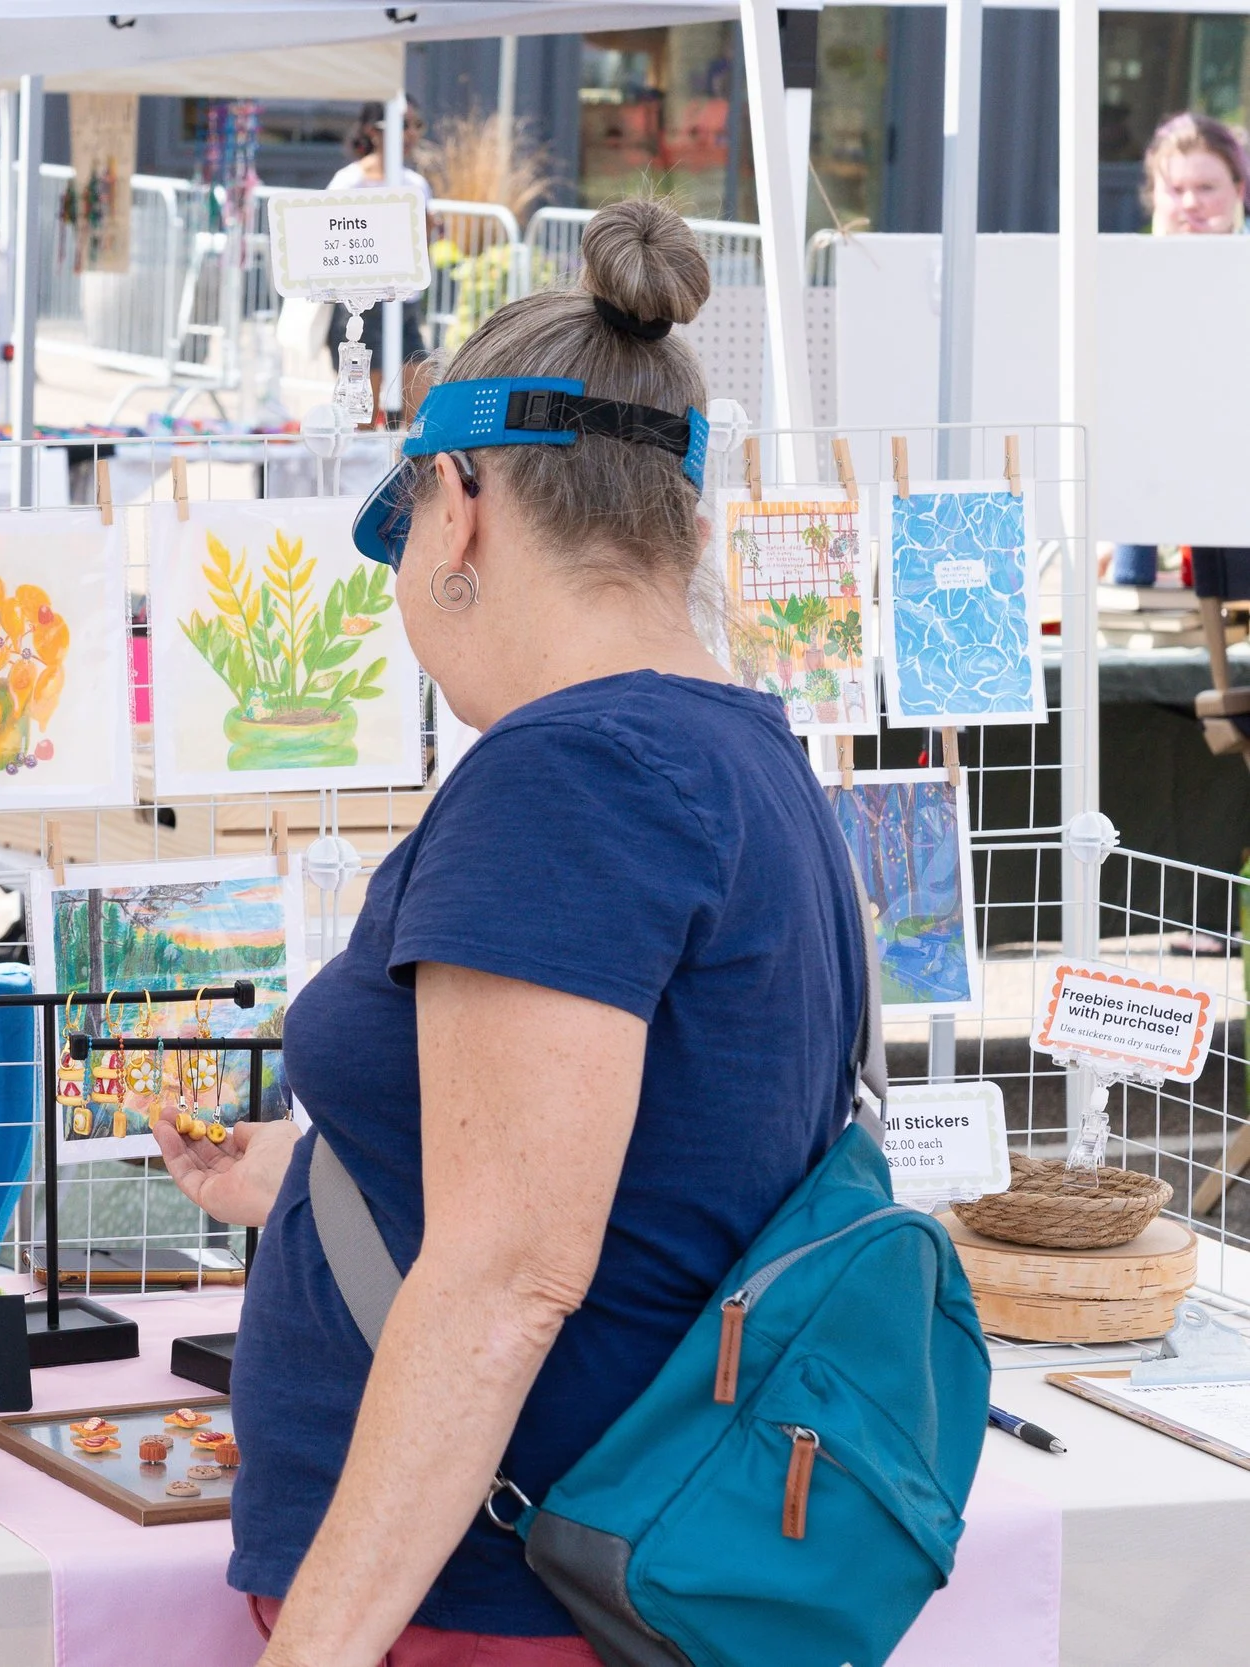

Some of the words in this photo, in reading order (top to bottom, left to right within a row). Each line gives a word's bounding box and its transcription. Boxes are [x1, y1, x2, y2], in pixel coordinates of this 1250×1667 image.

[329, 217, 368, 231] Prints
[324, 239, 340, 250] 5x7
[349, 238, 375, 249] $6.00
[322, 256, 340, 266] 8x8
[349, 254, 379, 265] $12.00
[1061, 988, 1123, 1010] Freebies
[1127, 1000, 1193, 1024] included
[1069, 1005, 1100, 1021] with
[1102, 1012, 1180, 1037] purchase!
[1060, 1023, 1076, 1034] Use
[1078, 1028, 1112, 1041] stickers
[1113, 1035, 1125, 1045] on
[1127, 1037, 1143, 1050] dry
[1144, 1042, 1182, 1056] surfaces
[885, 1117, 900, 1131] all
[905, 1115, 969, 1130] Stickers
[884, 1139, 915, 1151] $2.00
[918, 1138, 943, 1149] each
[887, 1156, 916, 1168] $5.00
[919, 1155, 935, 1166] for
[938, 1155, 944, 1165] 3
